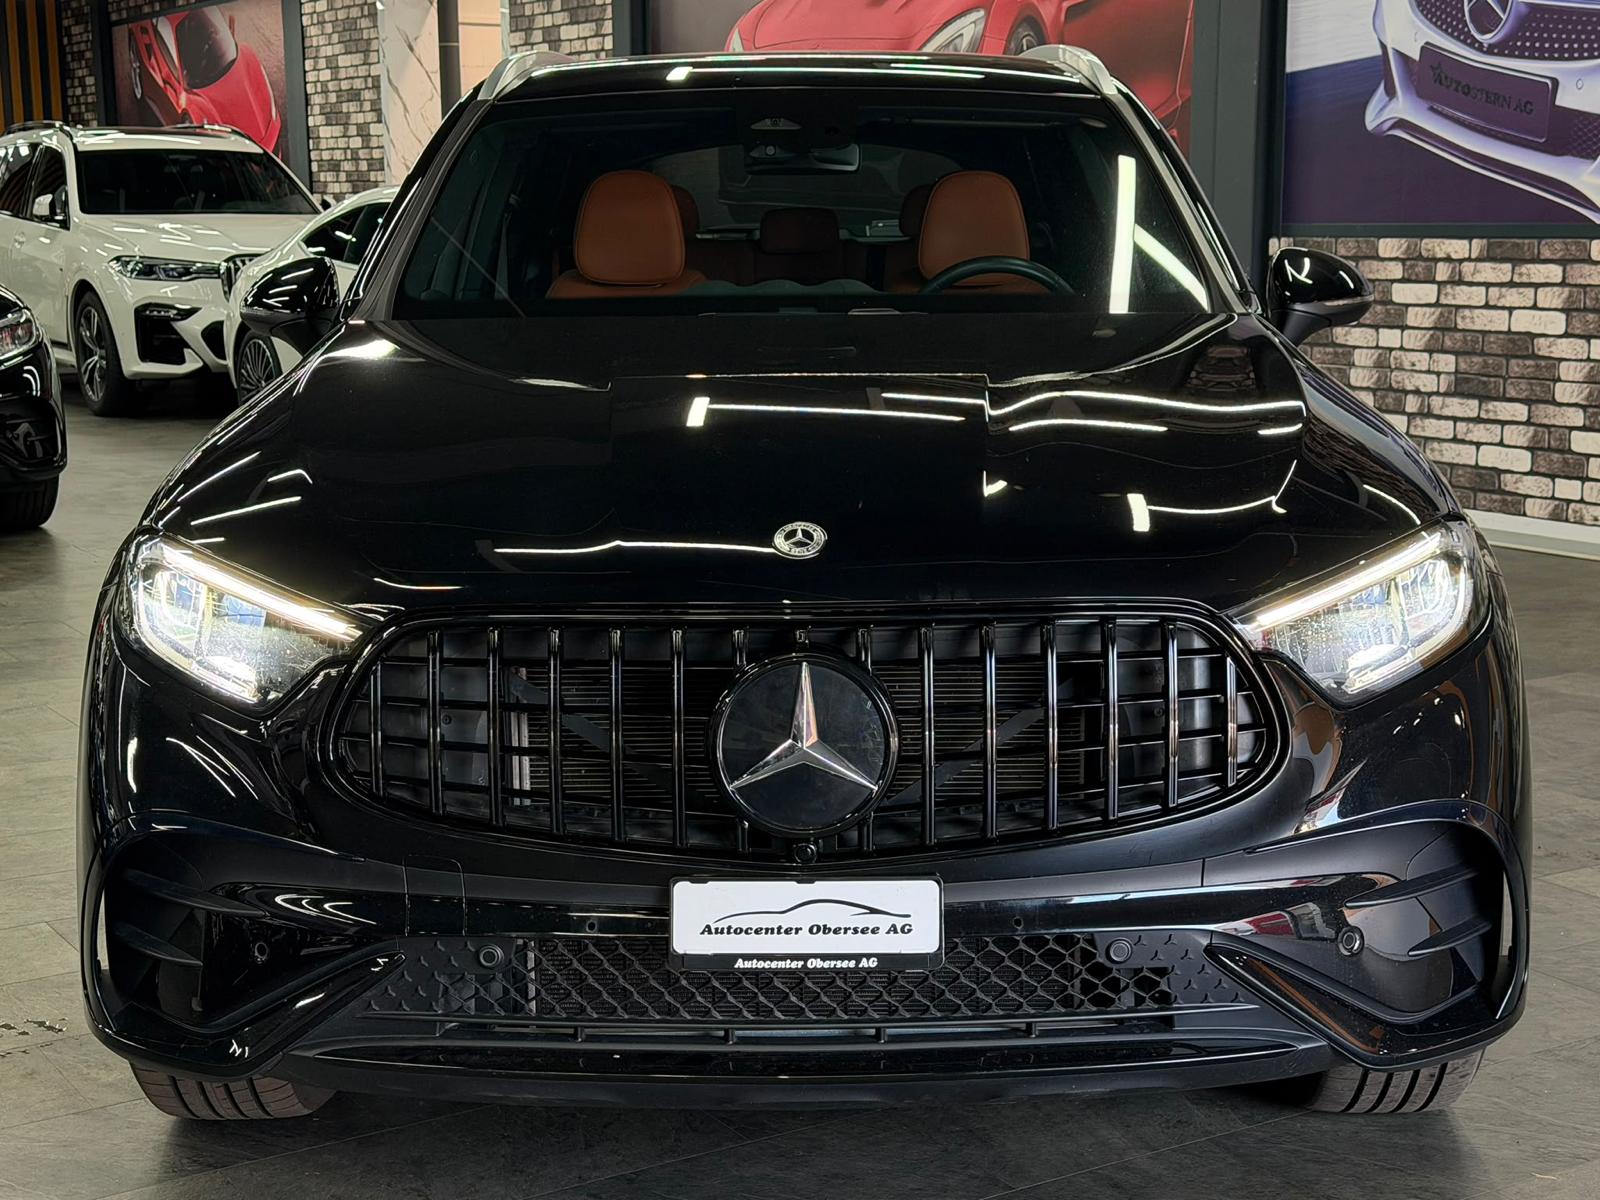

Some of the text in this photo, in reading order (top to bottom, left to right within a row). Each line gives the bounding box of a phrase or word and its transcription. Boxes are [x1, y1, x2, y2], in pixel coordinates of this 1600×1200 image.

[1432, 69, 1534, 115] AUTOSTERN AG
[700, 923, 913, 936] Autocenter Obersee AG
[734, 957, 878, 969] Autocenter Obersee AG
